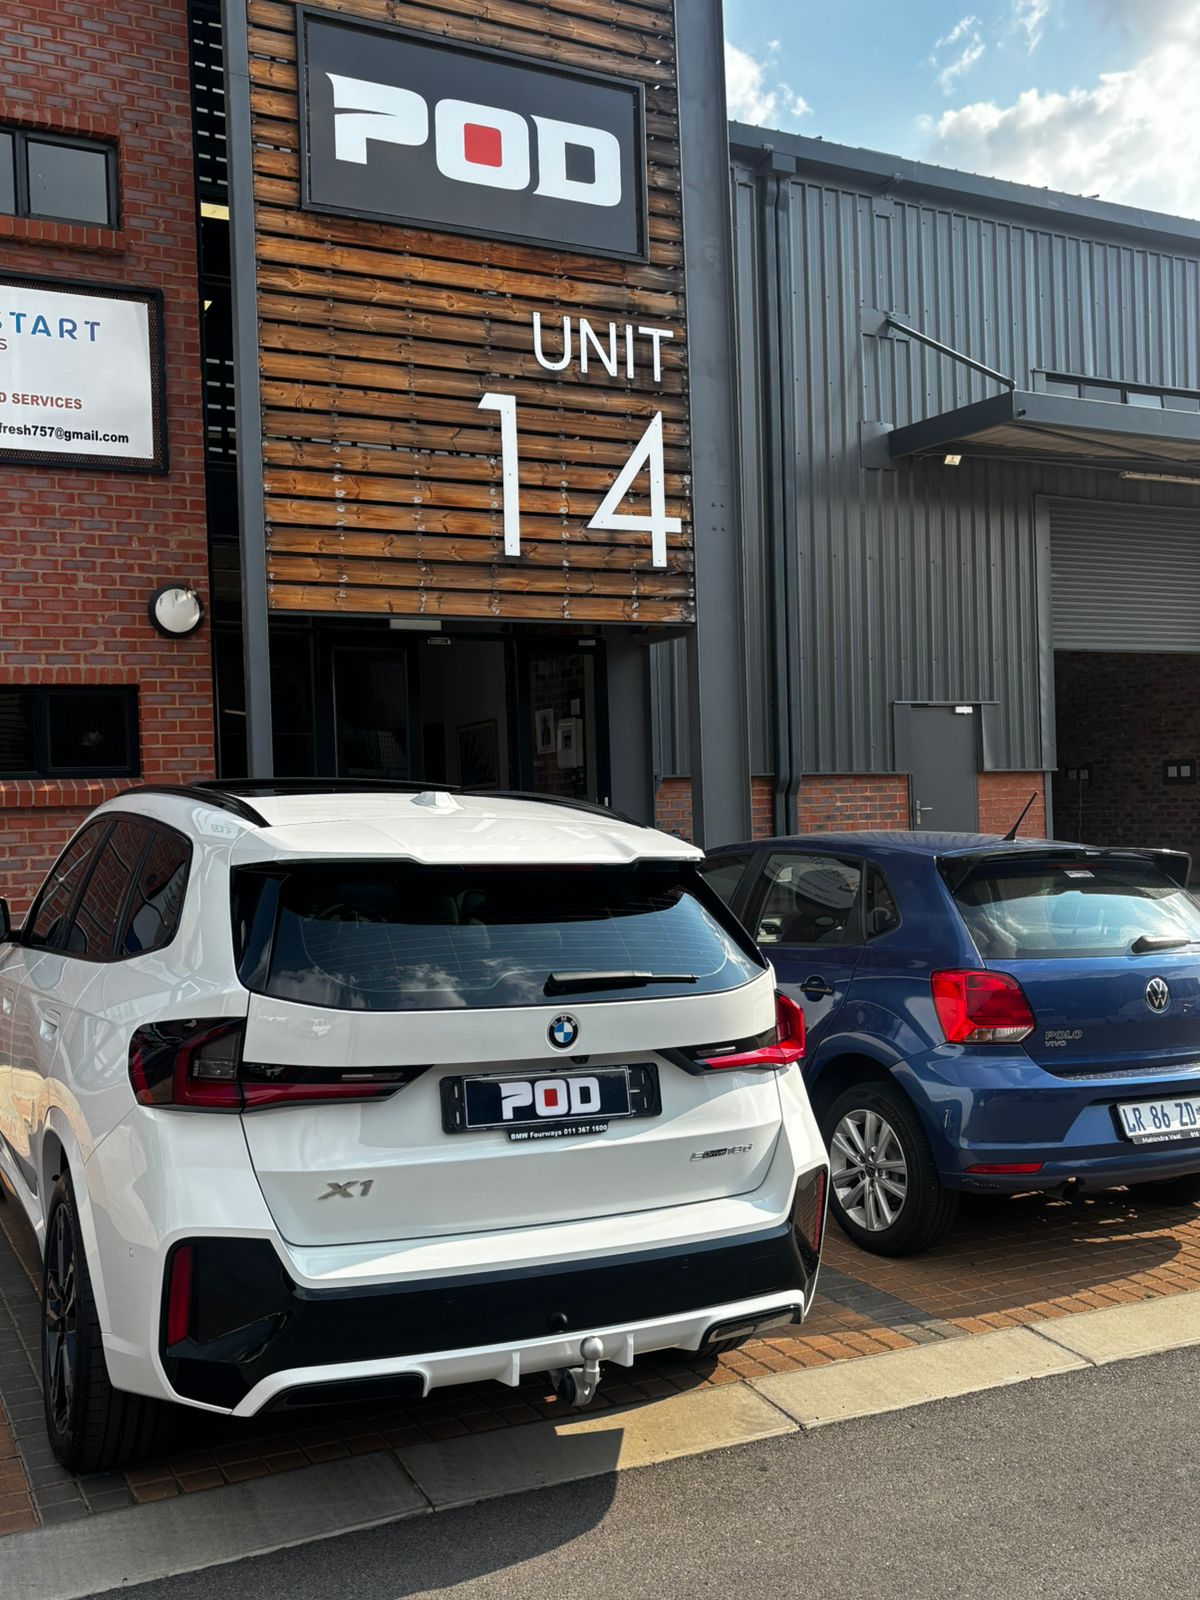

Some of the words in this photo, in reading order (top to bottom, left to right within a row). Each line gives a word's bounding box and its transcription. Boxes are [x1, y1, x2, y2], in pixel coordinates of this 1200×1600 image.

[325, 72, 622, 207] POD
[532, 311, 674, 383] UNIT
[11, 392, 82, 410] SERVICES
[477, 392, 682, 568] 14
[1045, 1029, 1083, 1040] POLO
[499, 1077, 601, 1120] POD
[1122, 1107, 1147, 1132] LR
[1150, 1105, 1171, 1129] 86
[1174, 1102, 1197, 1126] ZD
[510, 1132, 529, 1140] BMW
[529, 1129, 562, 1138] Fourways
[1142, 1135, 1169, 1143] Mahindra
[317, 1179, 374, 1200] X1
